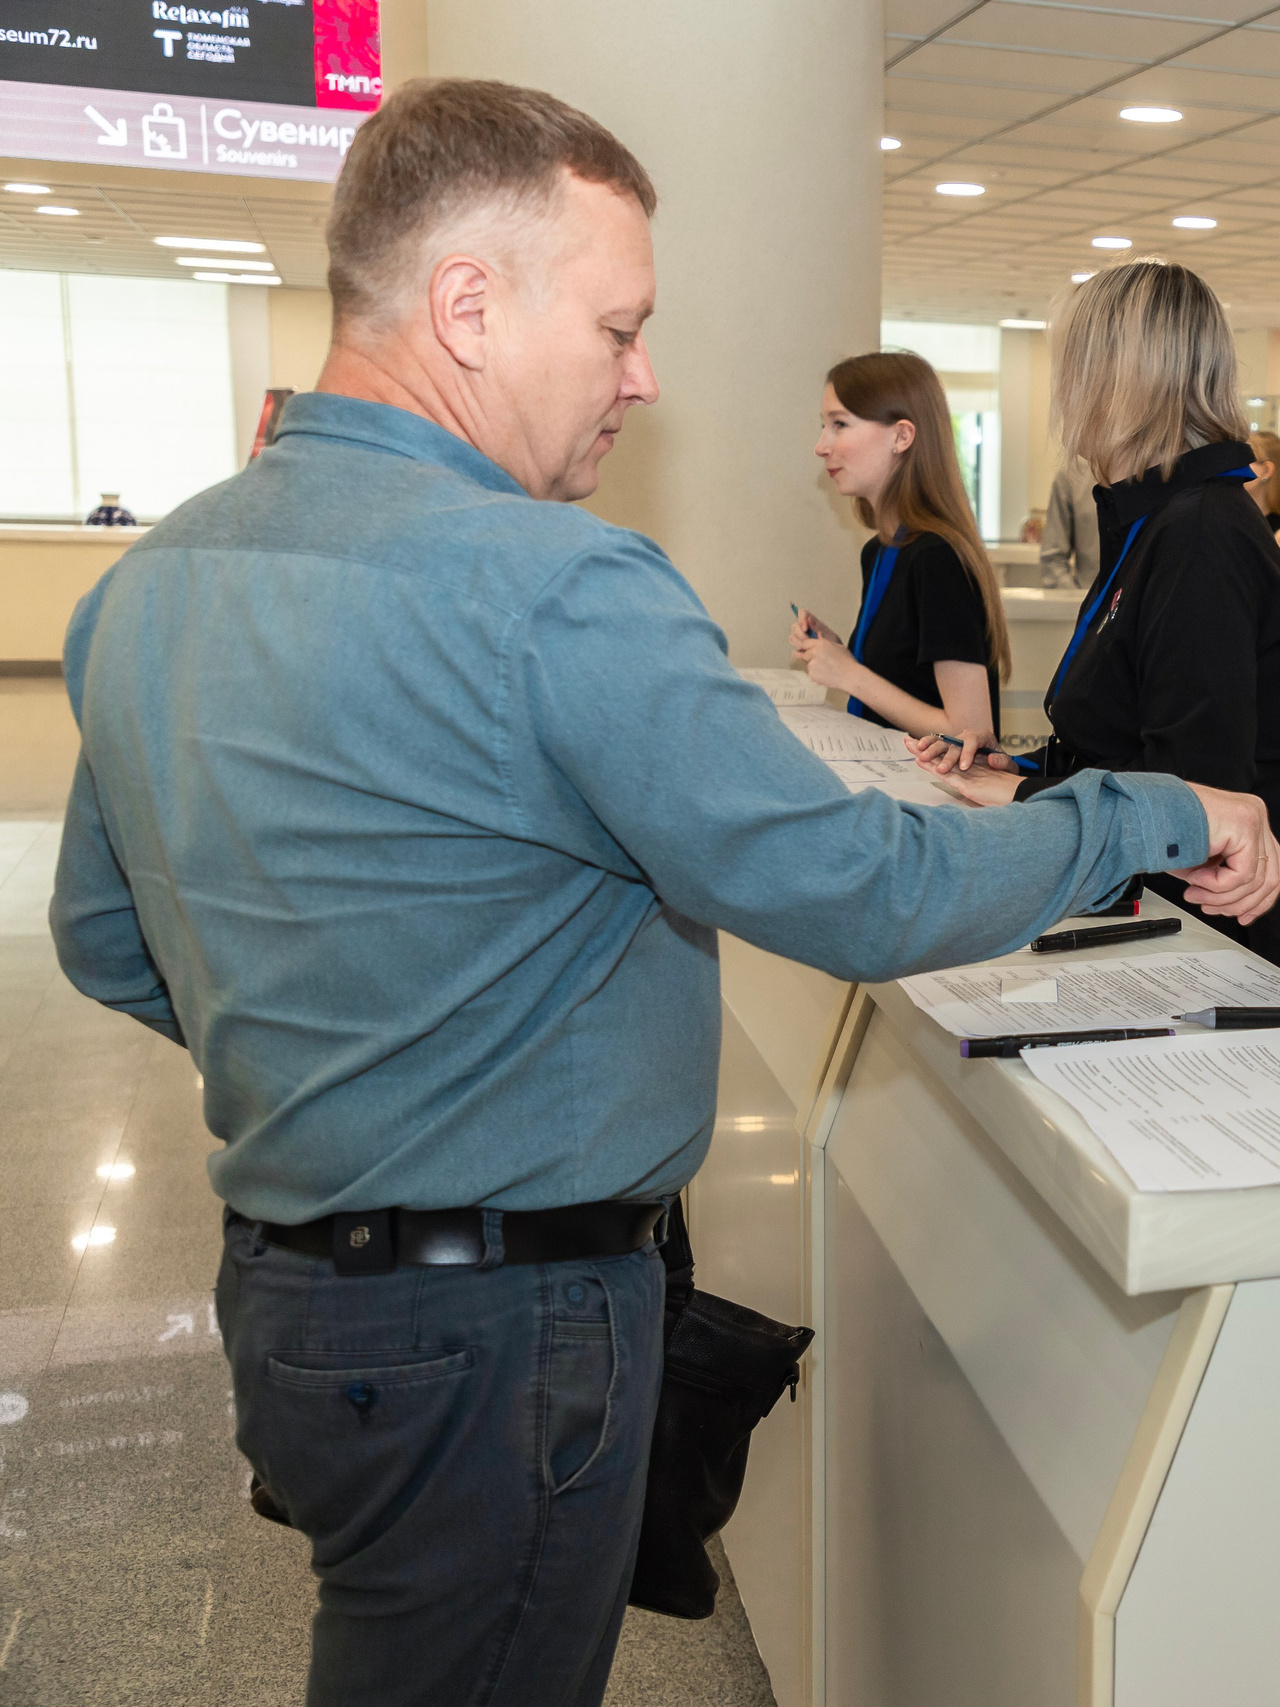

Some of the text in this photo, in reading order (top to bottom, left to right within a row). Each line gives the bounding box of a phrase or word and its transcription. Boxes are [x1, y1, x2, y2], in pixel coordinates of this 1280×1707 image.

[0, 28, 98, 50] seum72.ru
[213, 108, 356, 157] Сувенир
[216, 144, 298, 168] Souvenirs
